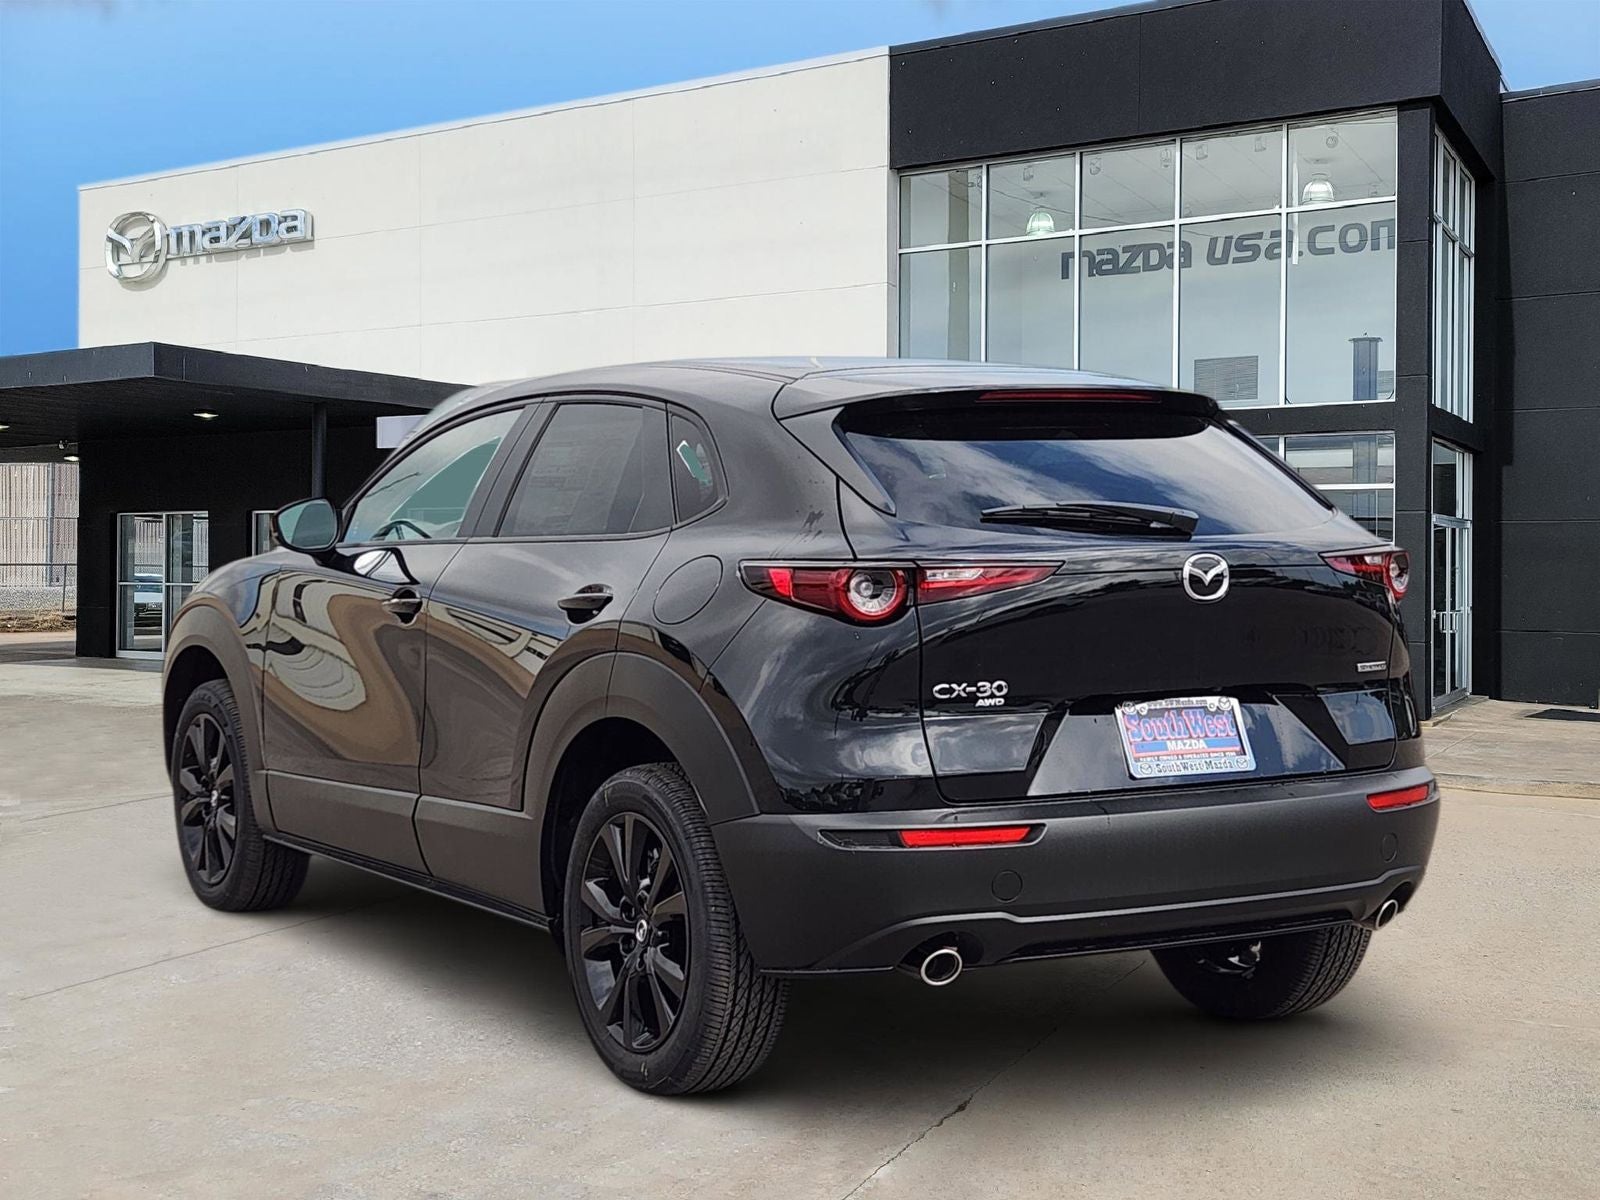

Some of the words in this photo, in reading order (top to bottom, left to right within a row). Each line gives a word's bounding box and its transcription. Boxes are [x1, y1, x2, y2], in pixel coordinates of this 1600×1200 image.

[166, 209, 313, 255] mazda
[1061, 239, 1192, 280] mazda
[932, 680, 1008, 699] CX-30
[975, 698, 1005, 707] AWD
[1124, 709, 1237, 741] SouthWest
[1166, 739, 1208, 751] MAZDA
